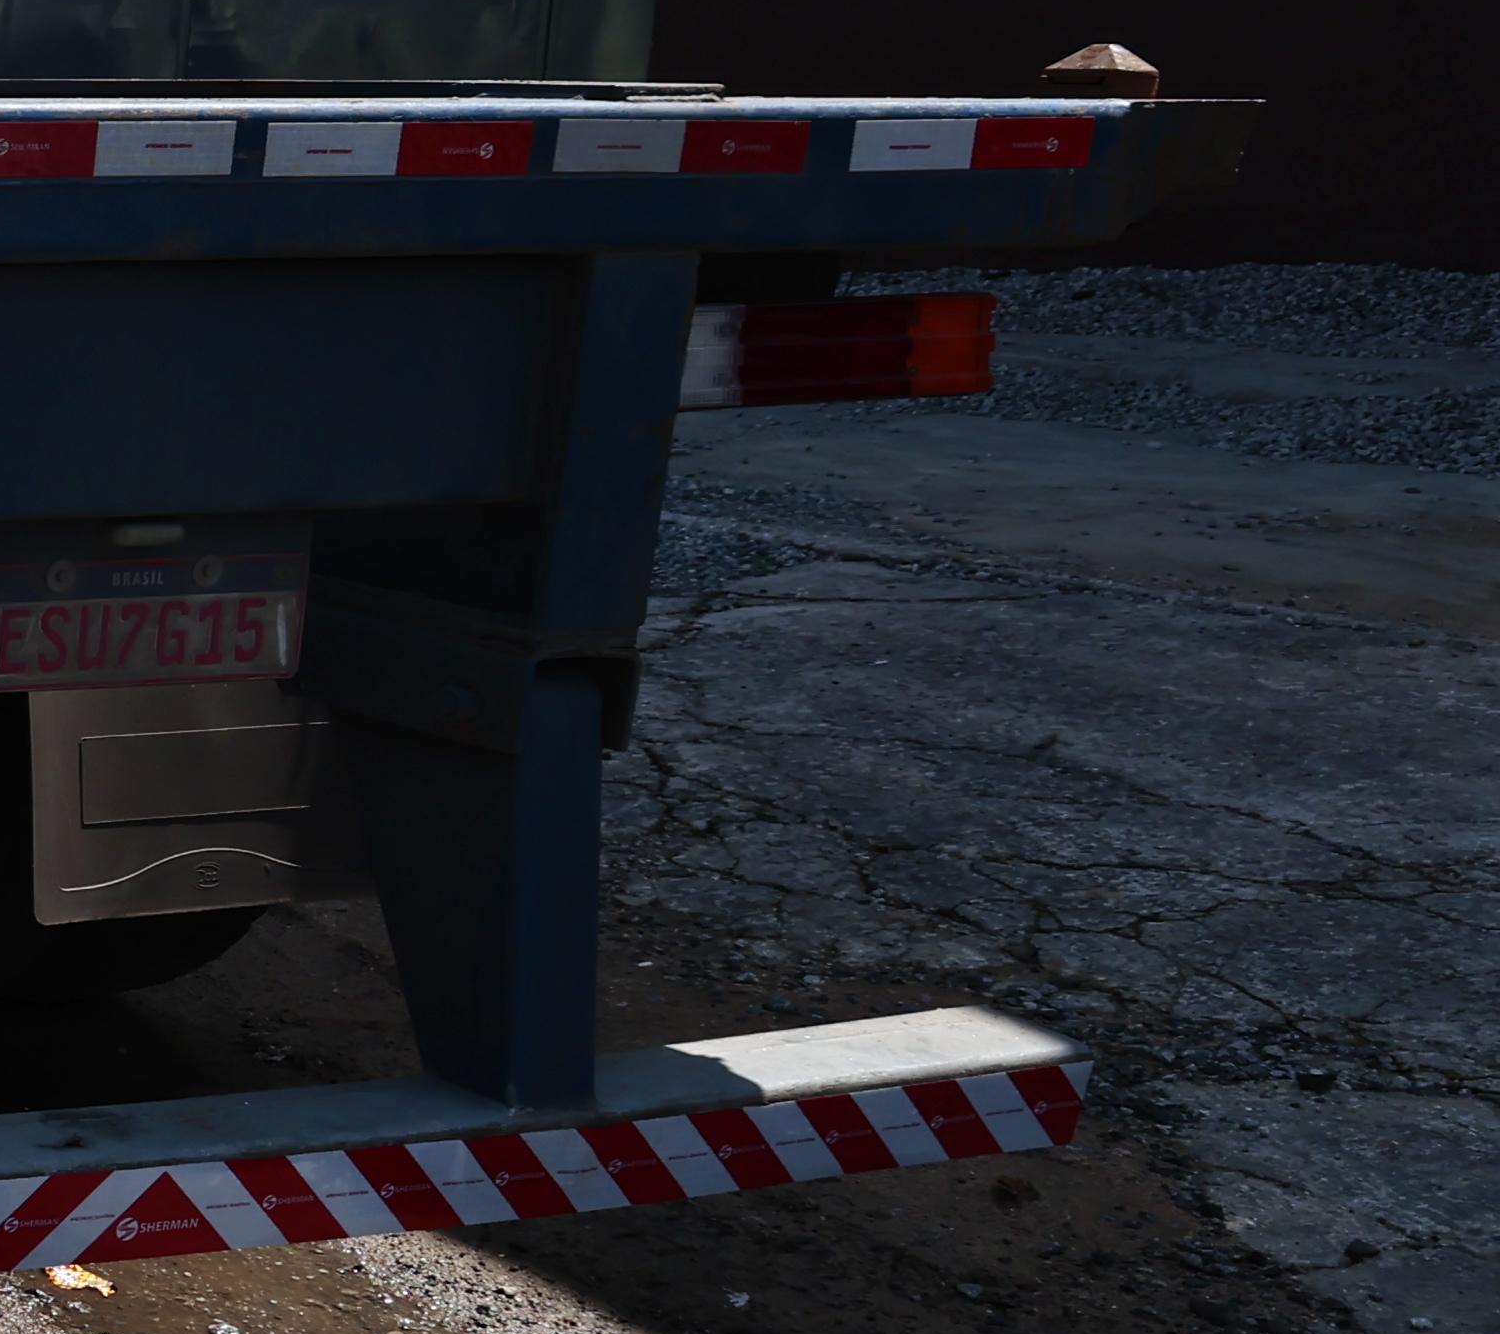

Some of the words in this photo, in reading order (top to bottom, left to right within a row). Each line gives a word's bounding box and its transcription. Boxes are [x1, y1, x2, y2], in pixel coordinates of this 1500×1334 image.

[112, 571, 165, 588] BRASIL
[18, 1217, 60, 1229] SHERMAN
[139, 1217, 199, 1234] SHERMAN
